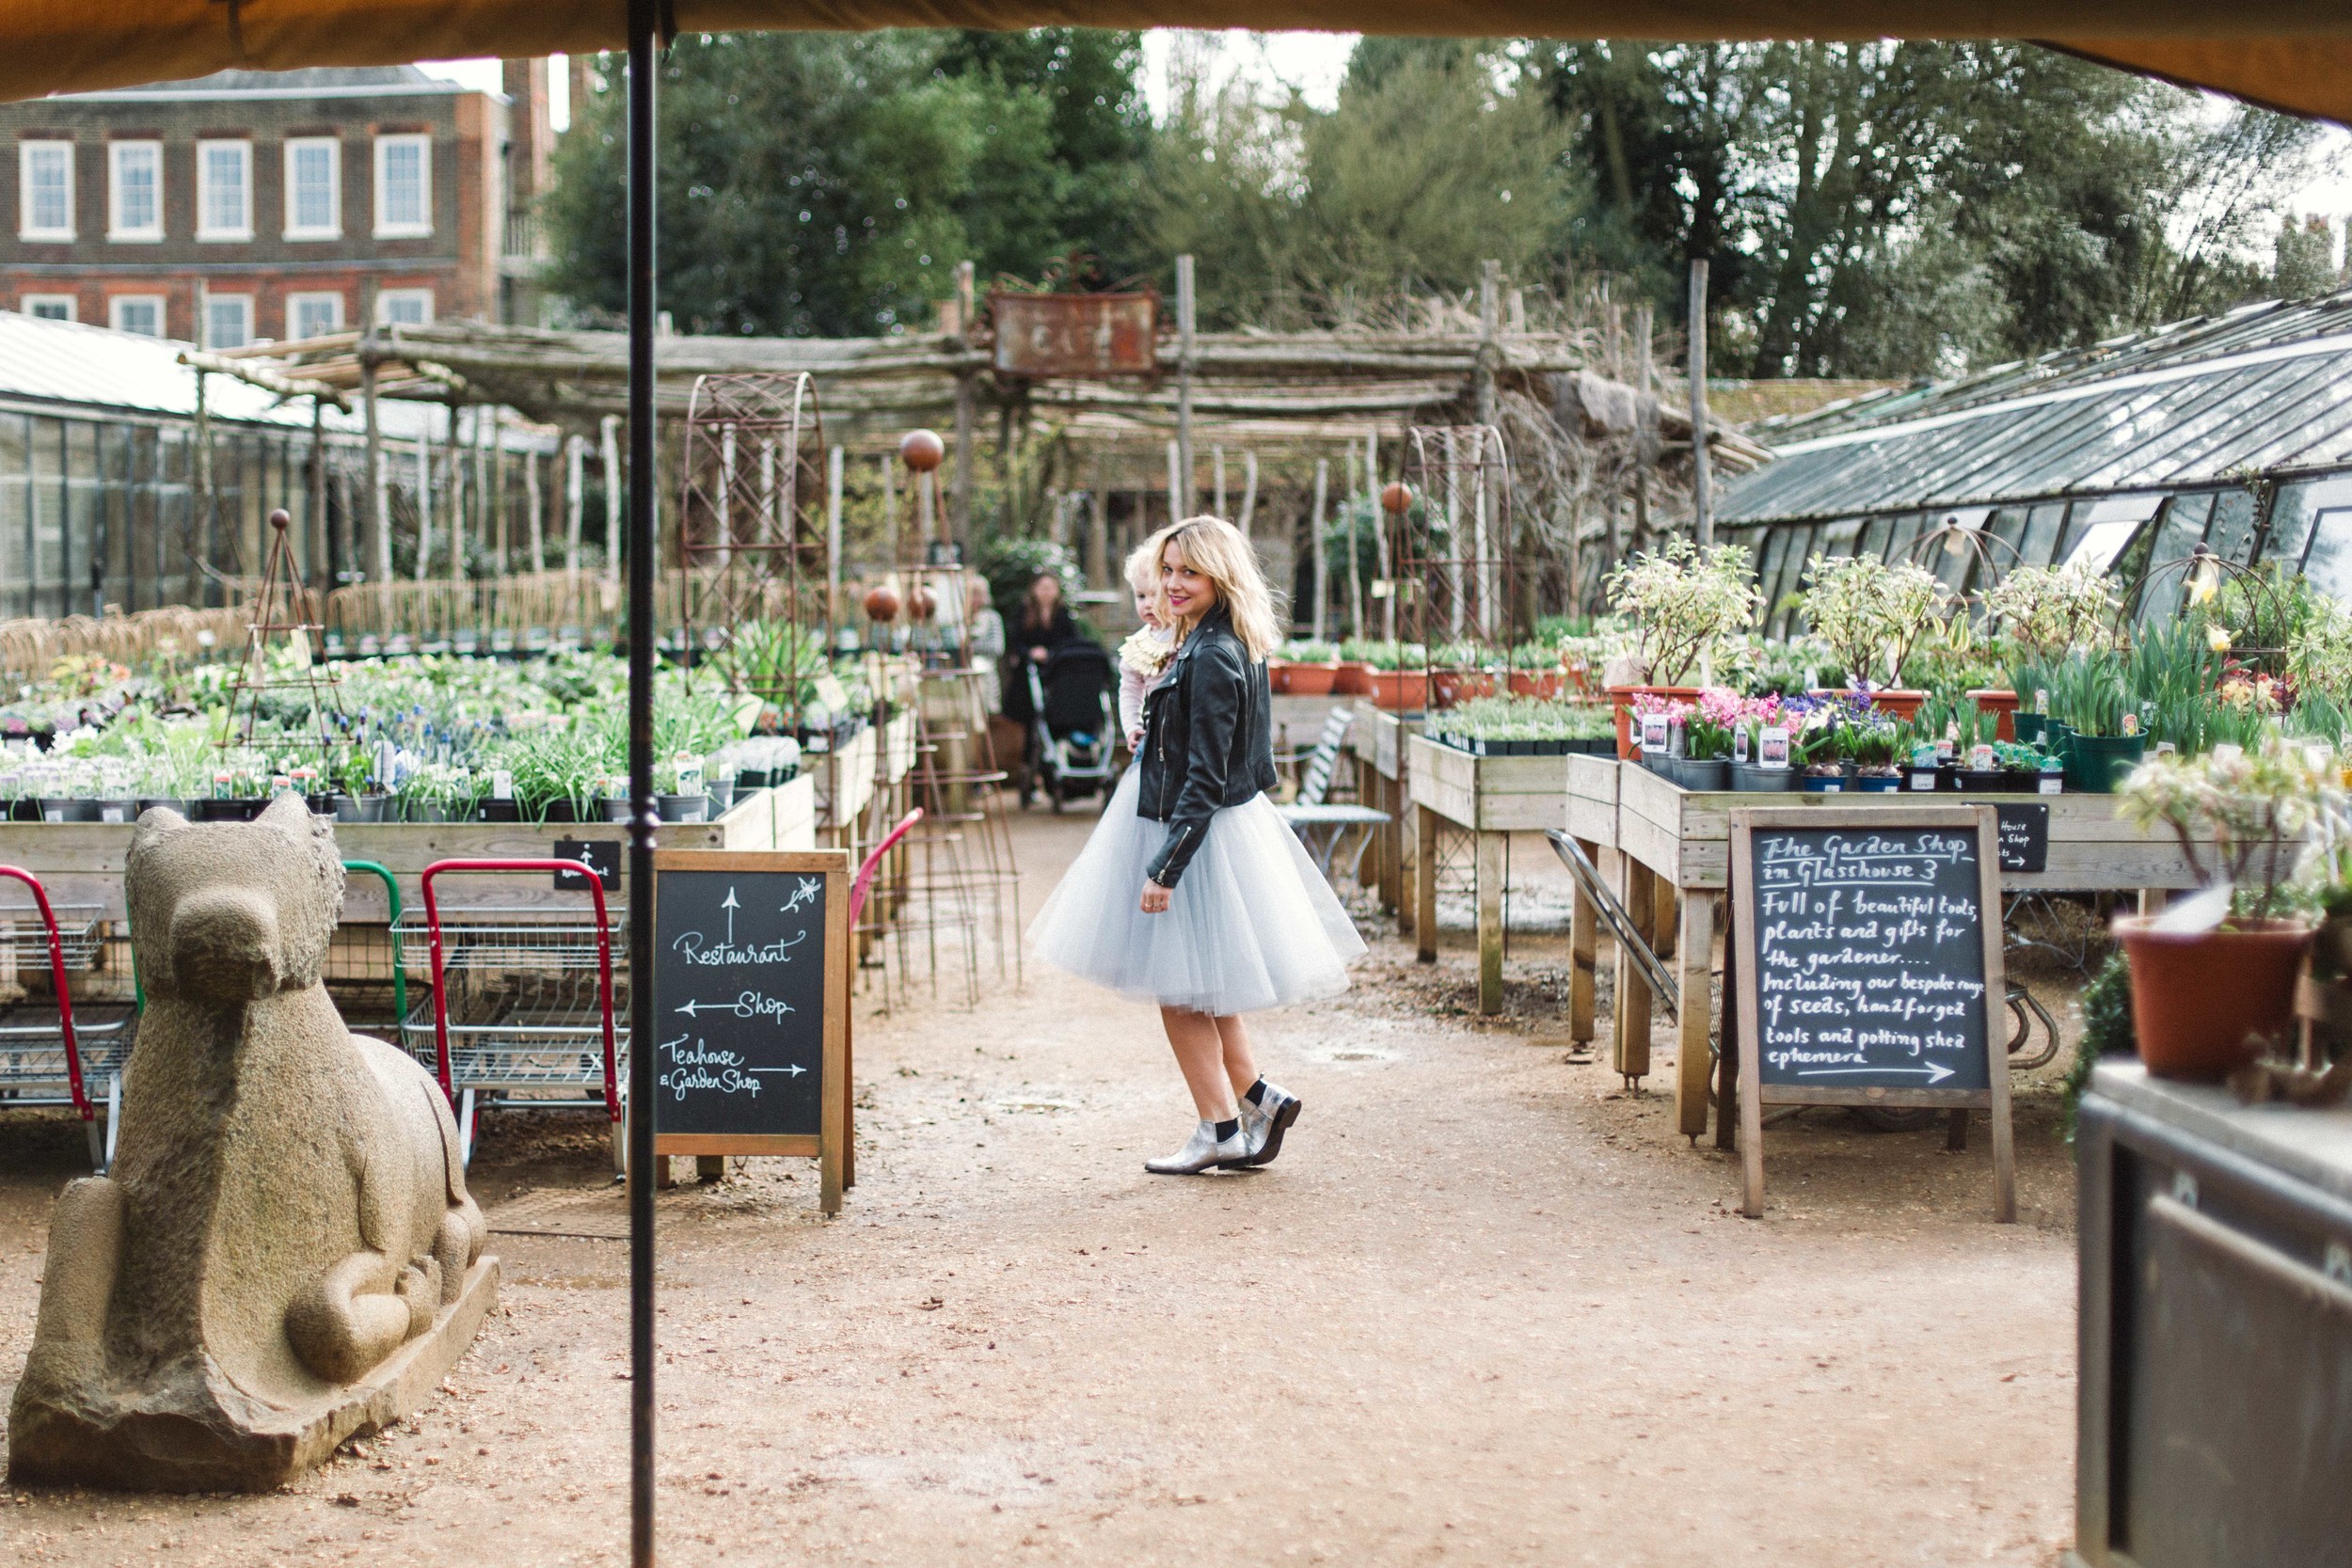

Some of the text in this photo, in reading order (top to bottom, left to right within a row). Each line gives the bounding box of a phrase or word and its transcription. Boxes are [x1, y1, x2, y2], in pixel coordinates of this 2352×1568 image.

[2001, 820, 2026, 832] House
[2008, 833, 2030, 847] Shop
[1761, 834, 1967, 867] The Garden Shop
[1762, 859, 1938, 887] in Glasshouse 3
[1762, 890, 1978, 924] Full of beautiful tools,
[673, 931, 806, 966] Restaurant
[1762, 918, 1965, 955] plants and gifts for
[1766, 949, 1799, 968] the
[1763, 971, 1985, 1000] Including our bespoke range
[735, 990, 796, 1025] Shop
[1764, 994, 1783, 1026] of
[1789, 995, 1850, 1018] seeds,
[660, 1033, 745, 1067] Teahouse
[1766, 1026, 1965, 1056] tools and potting shed
[1769, 1047, 1868, 1069] ephemera
